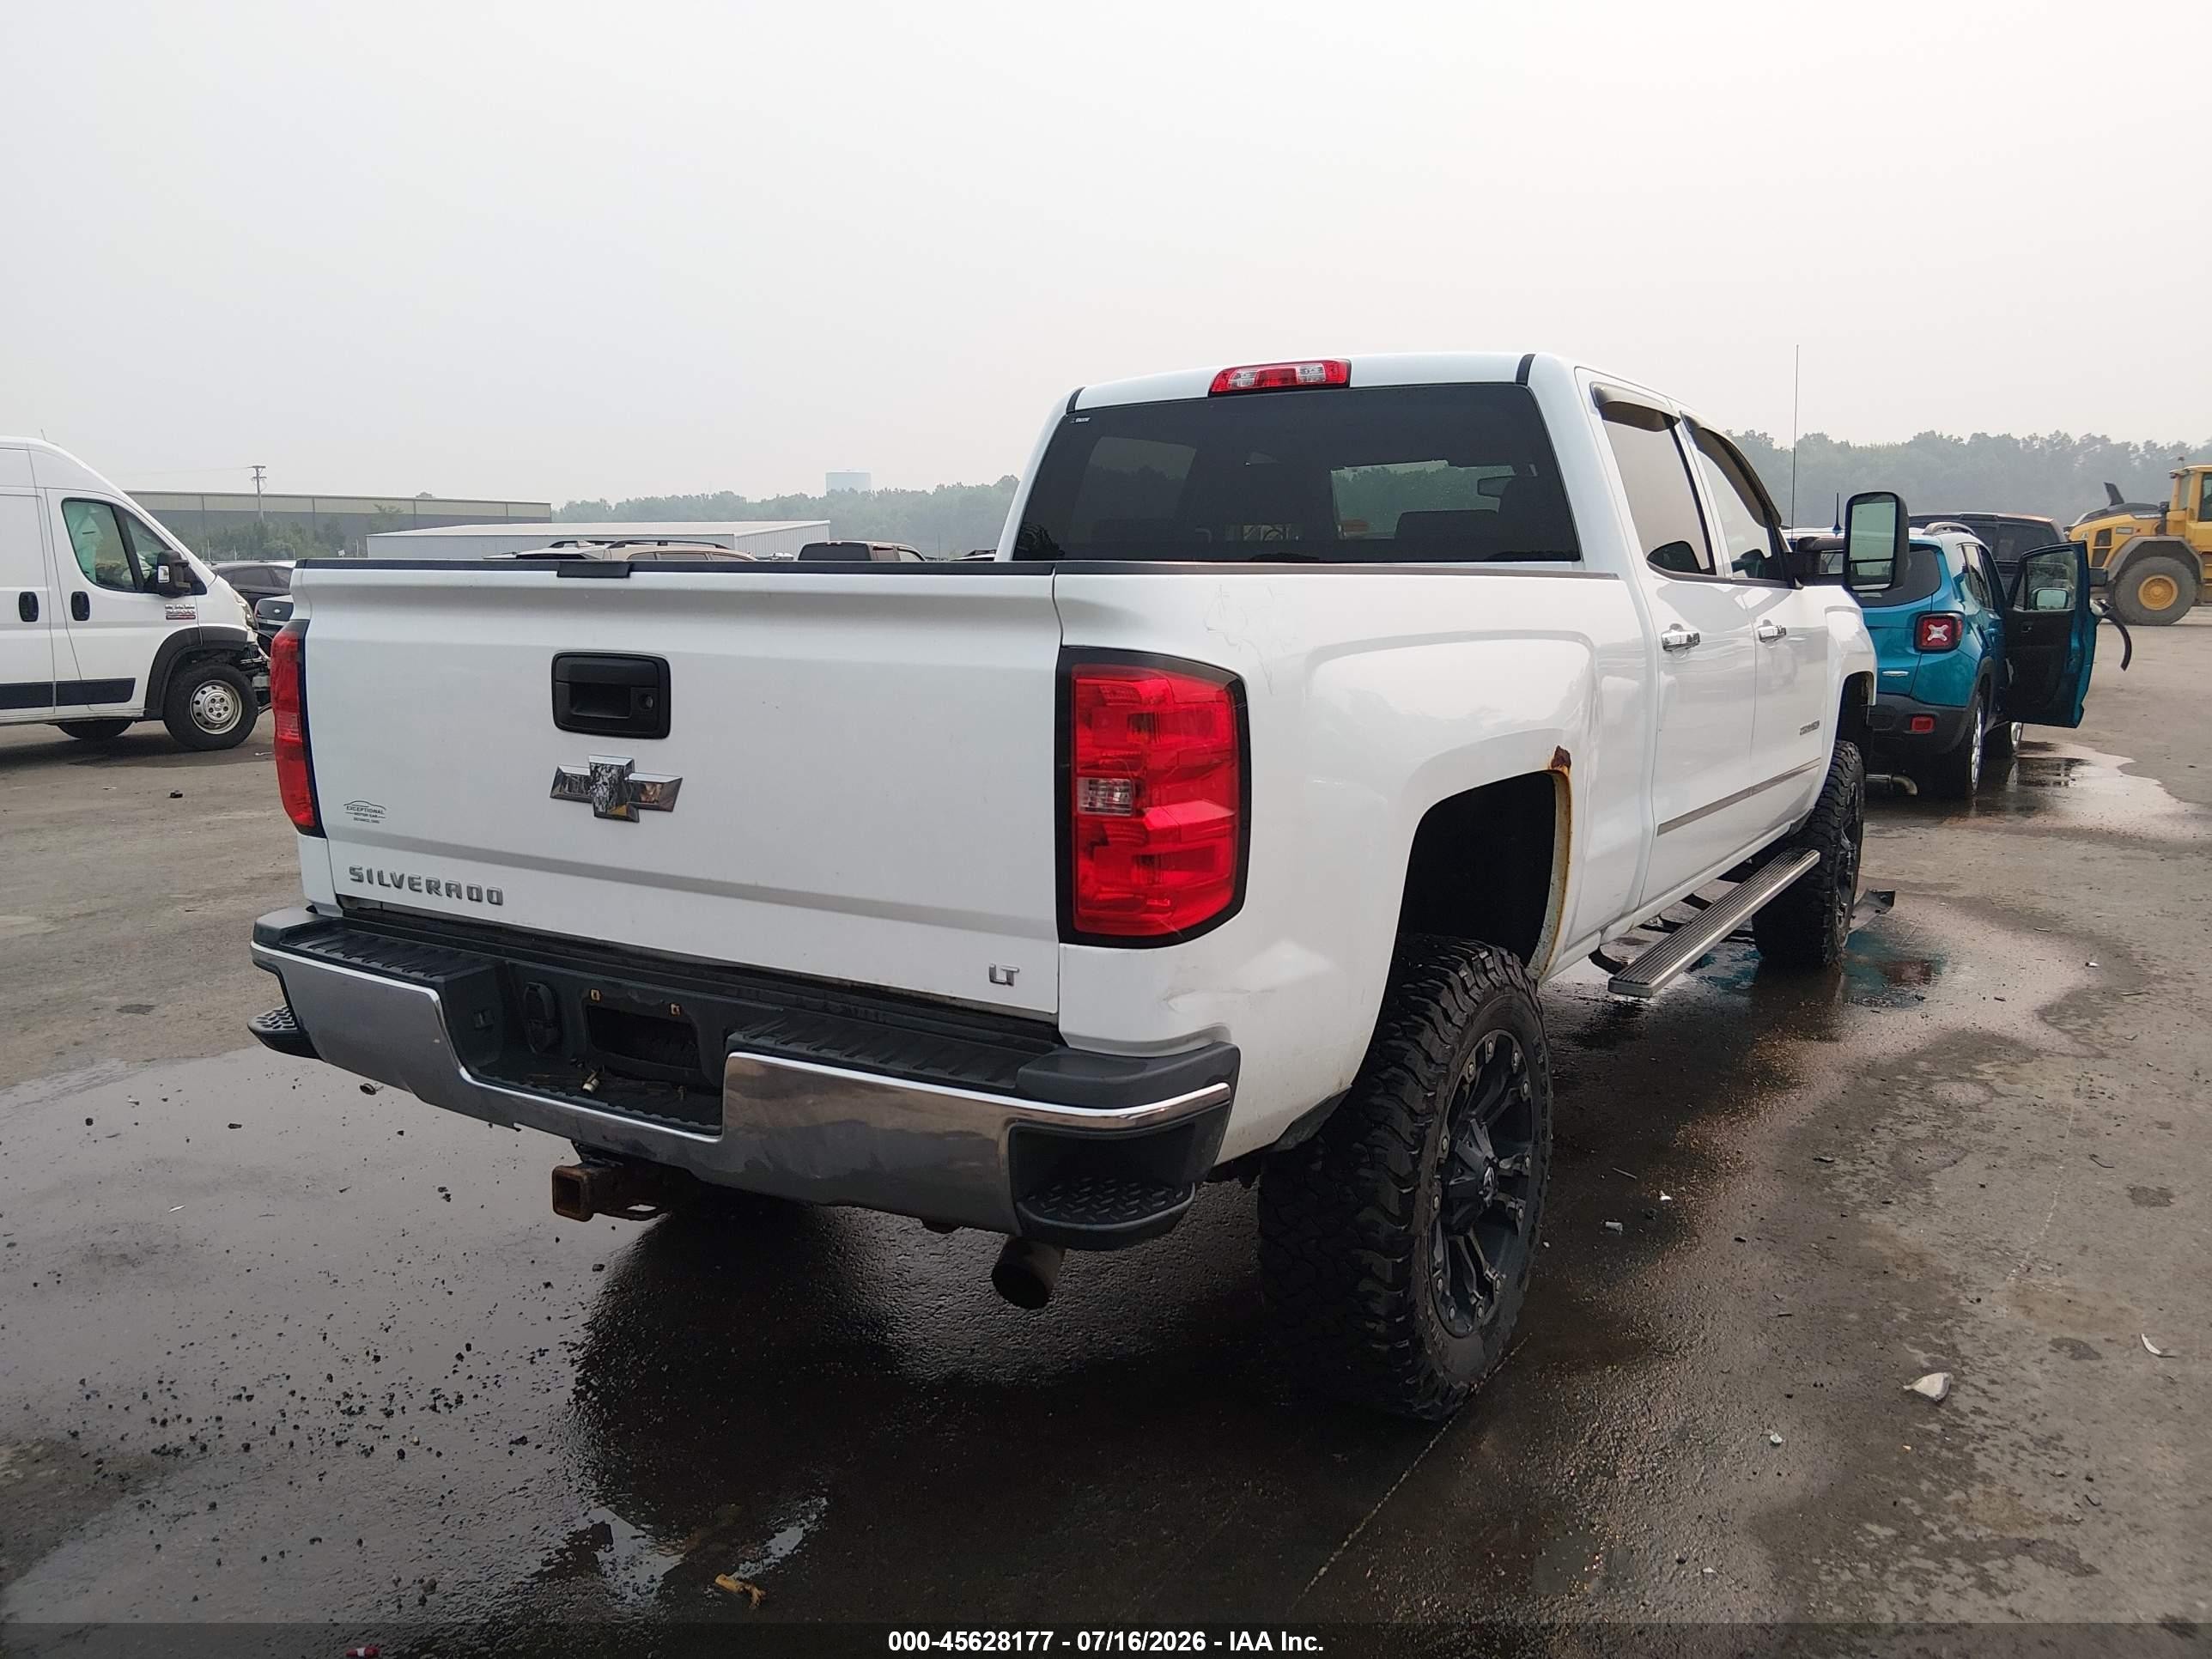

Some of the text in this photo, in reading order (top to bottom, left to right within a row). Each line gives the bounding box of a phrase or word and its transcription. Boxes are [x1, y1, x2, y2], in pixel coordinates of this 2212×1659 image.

[347, 805, 385, 815] EXCEPTIONAL
[349, 865, 504, 906] SILVERADO
[988, 963, 1020, 987] LT
